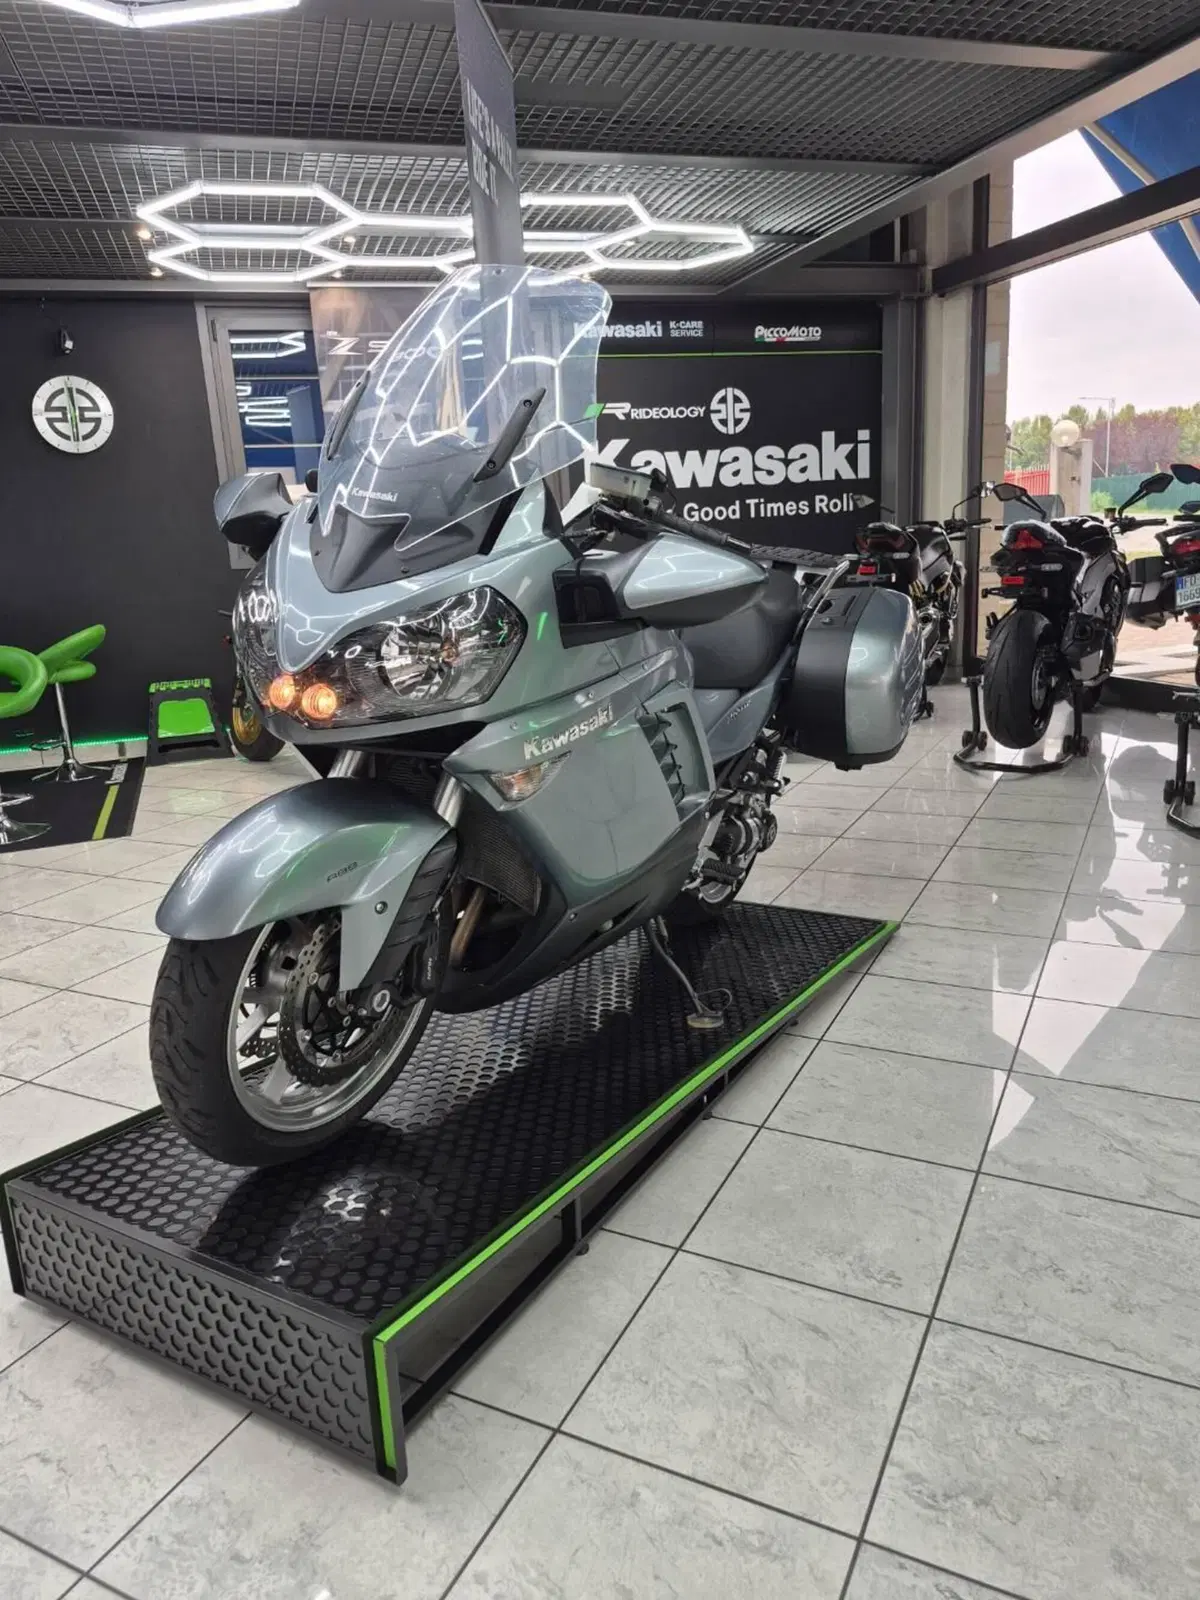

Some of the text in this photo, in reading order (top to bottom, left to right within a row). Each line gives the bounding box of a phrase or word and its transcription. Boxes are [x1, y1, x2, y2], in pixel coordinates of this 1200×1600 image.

[573, 320, 663, 338] Kawasaki
[670, 328, 704, 338] SERVICE
[630, 406, 706, 420] RIDEOLOGY
[583, 429, 871, 490] Kawasaki
[351, 487, 399, 502] Kawasaki
[683, 492, 854, 522] Good Times Roll
[523, 702, 614, 760] Kawasaki
